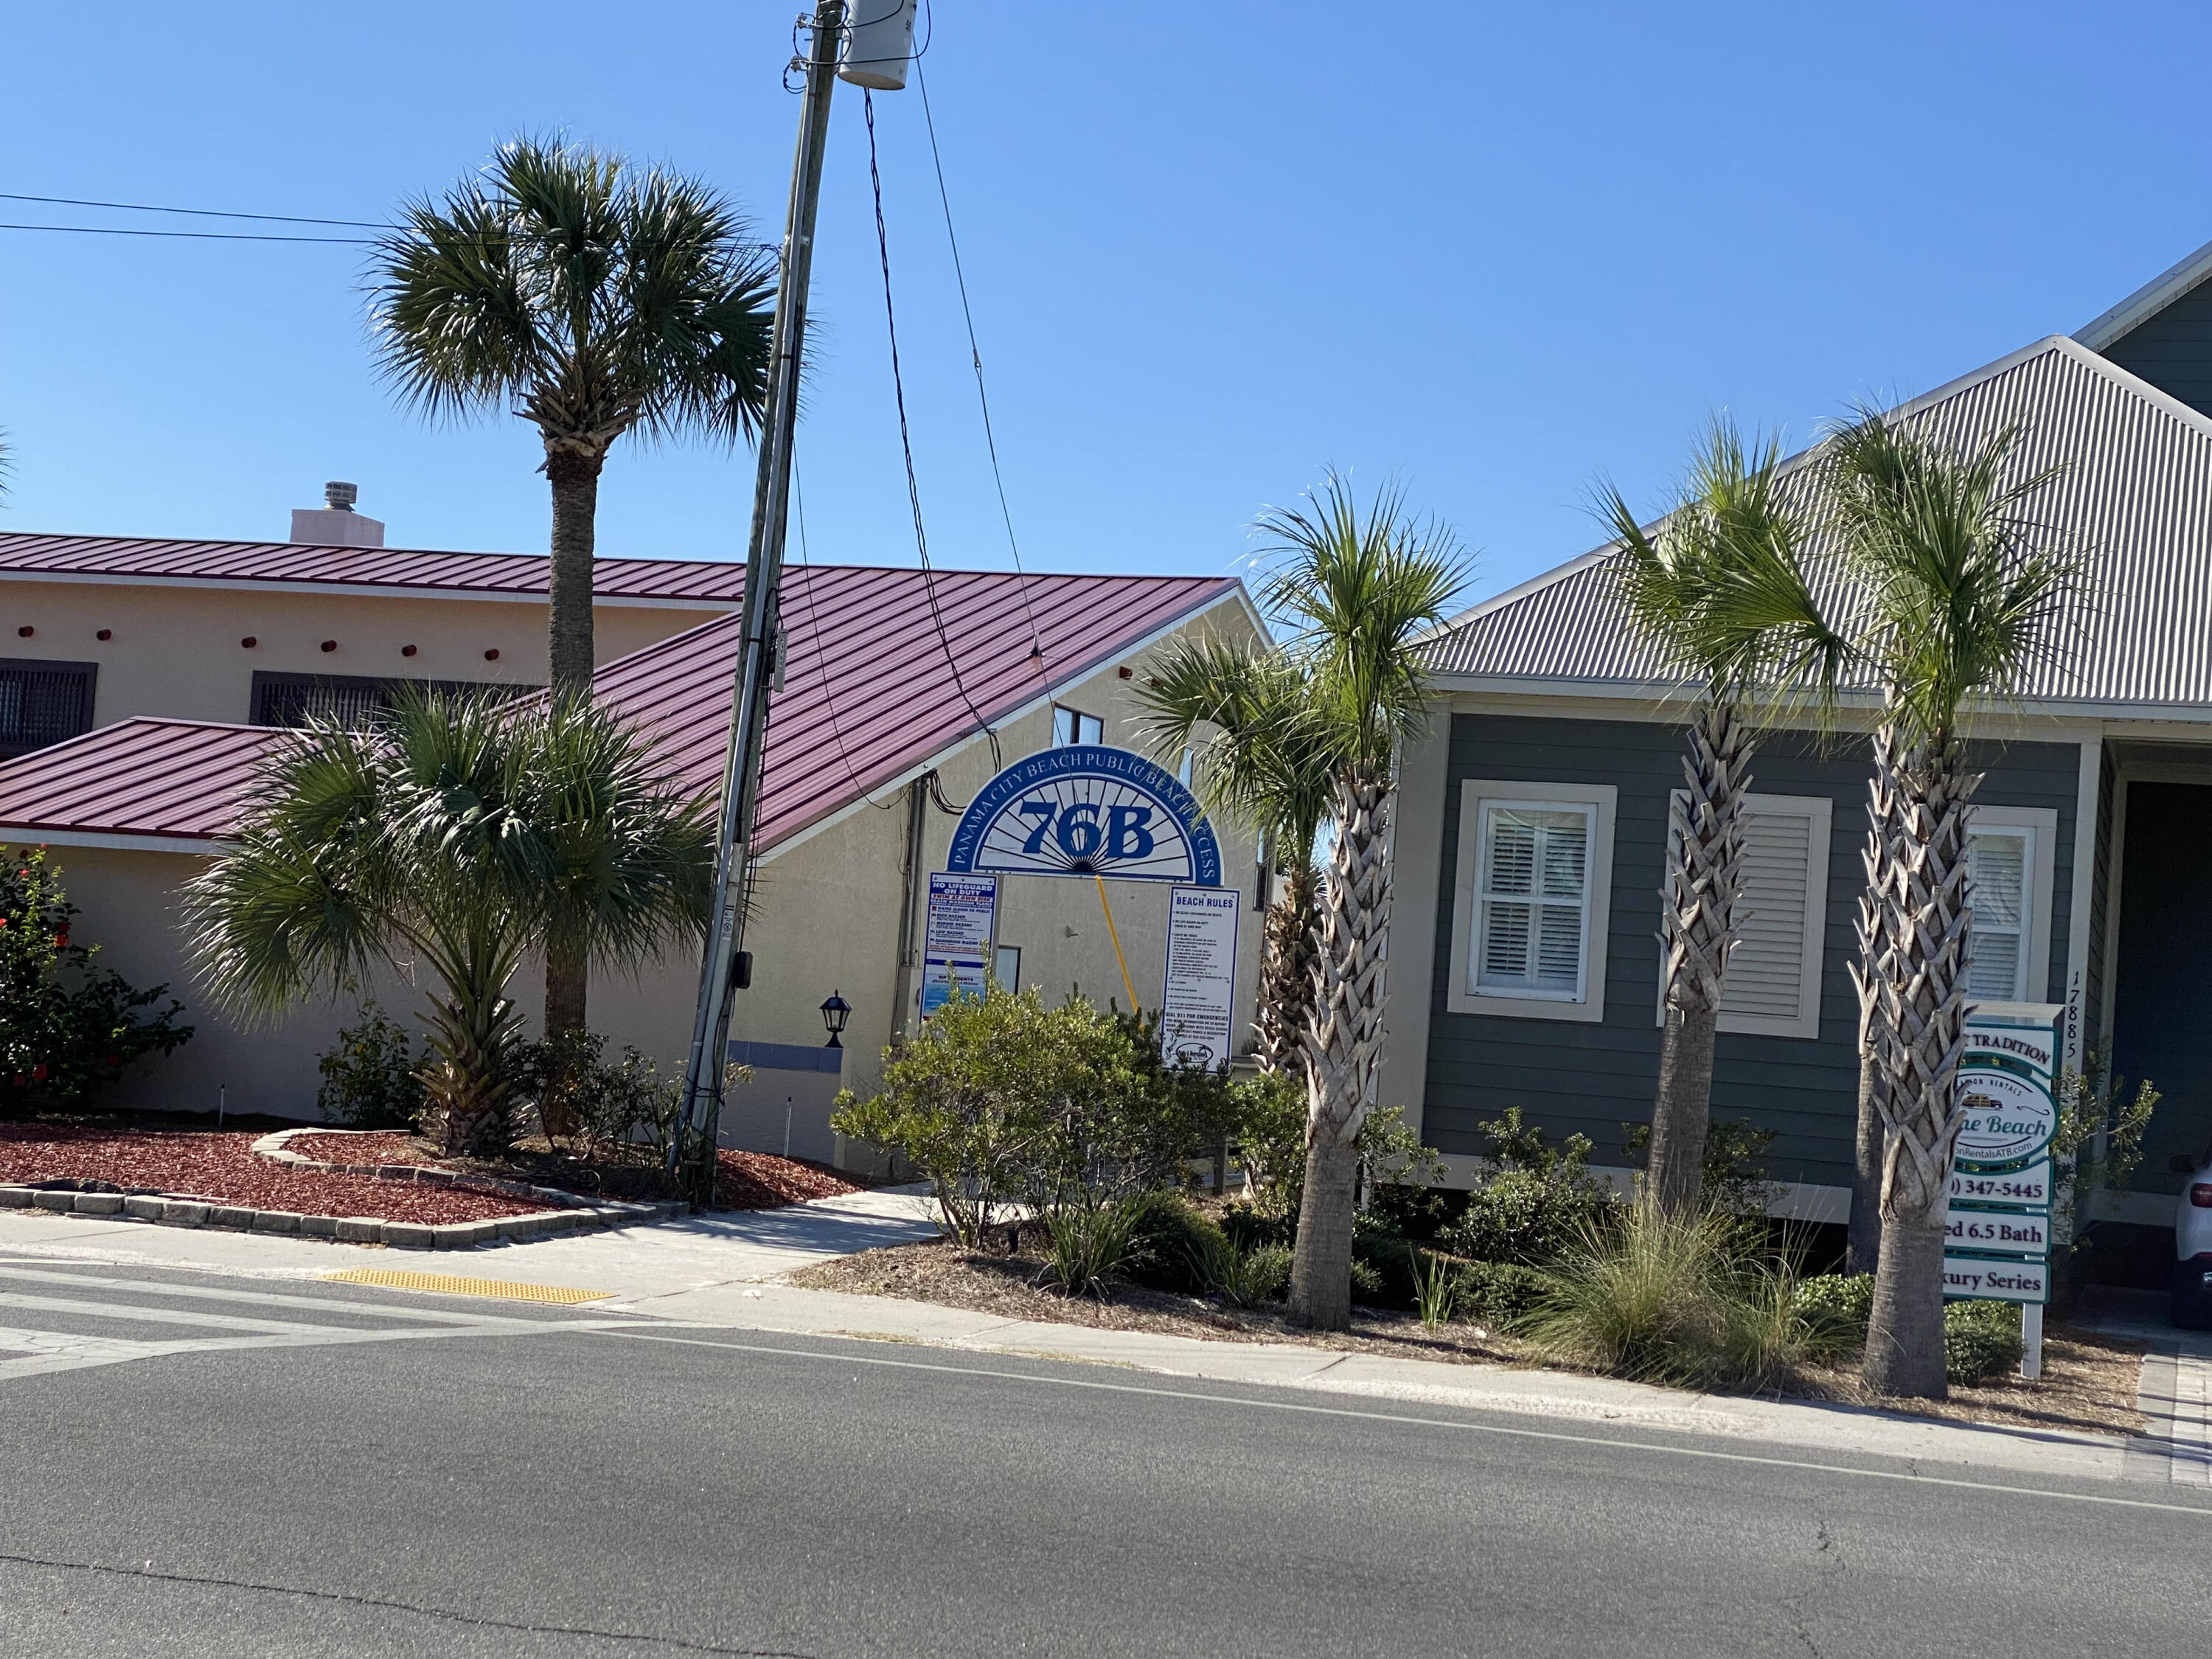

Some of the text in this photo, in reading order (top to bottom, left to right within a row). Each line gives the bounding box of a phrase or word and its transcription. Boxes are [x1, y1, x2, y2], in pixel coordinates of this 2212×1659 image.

[955, 754, 1215, 878] PANAMA CITY BEACH PUBLIC BEACH CCESS
[1018, 800, 1154, 859] 76B
[948, 883, 992, 891] LIFEGUARD
[1176, 897, 1234, 908] BEACH RULES
[2067, 971, 2080, 1058] 17885
[1973, 1034, 2050, 1065] TRADITION
[1989, 1079, 2023, 1096] RENTALS
[1986, 1116, 2047, 1136] Beach
[1966, 1180, 2043, 1198] 347-5445
[1969, 1223, 1994, 1239] 6.5
[1999, 1225, 2042, 1242] Bath
[1986, 1272, 2041, 1290] Series
